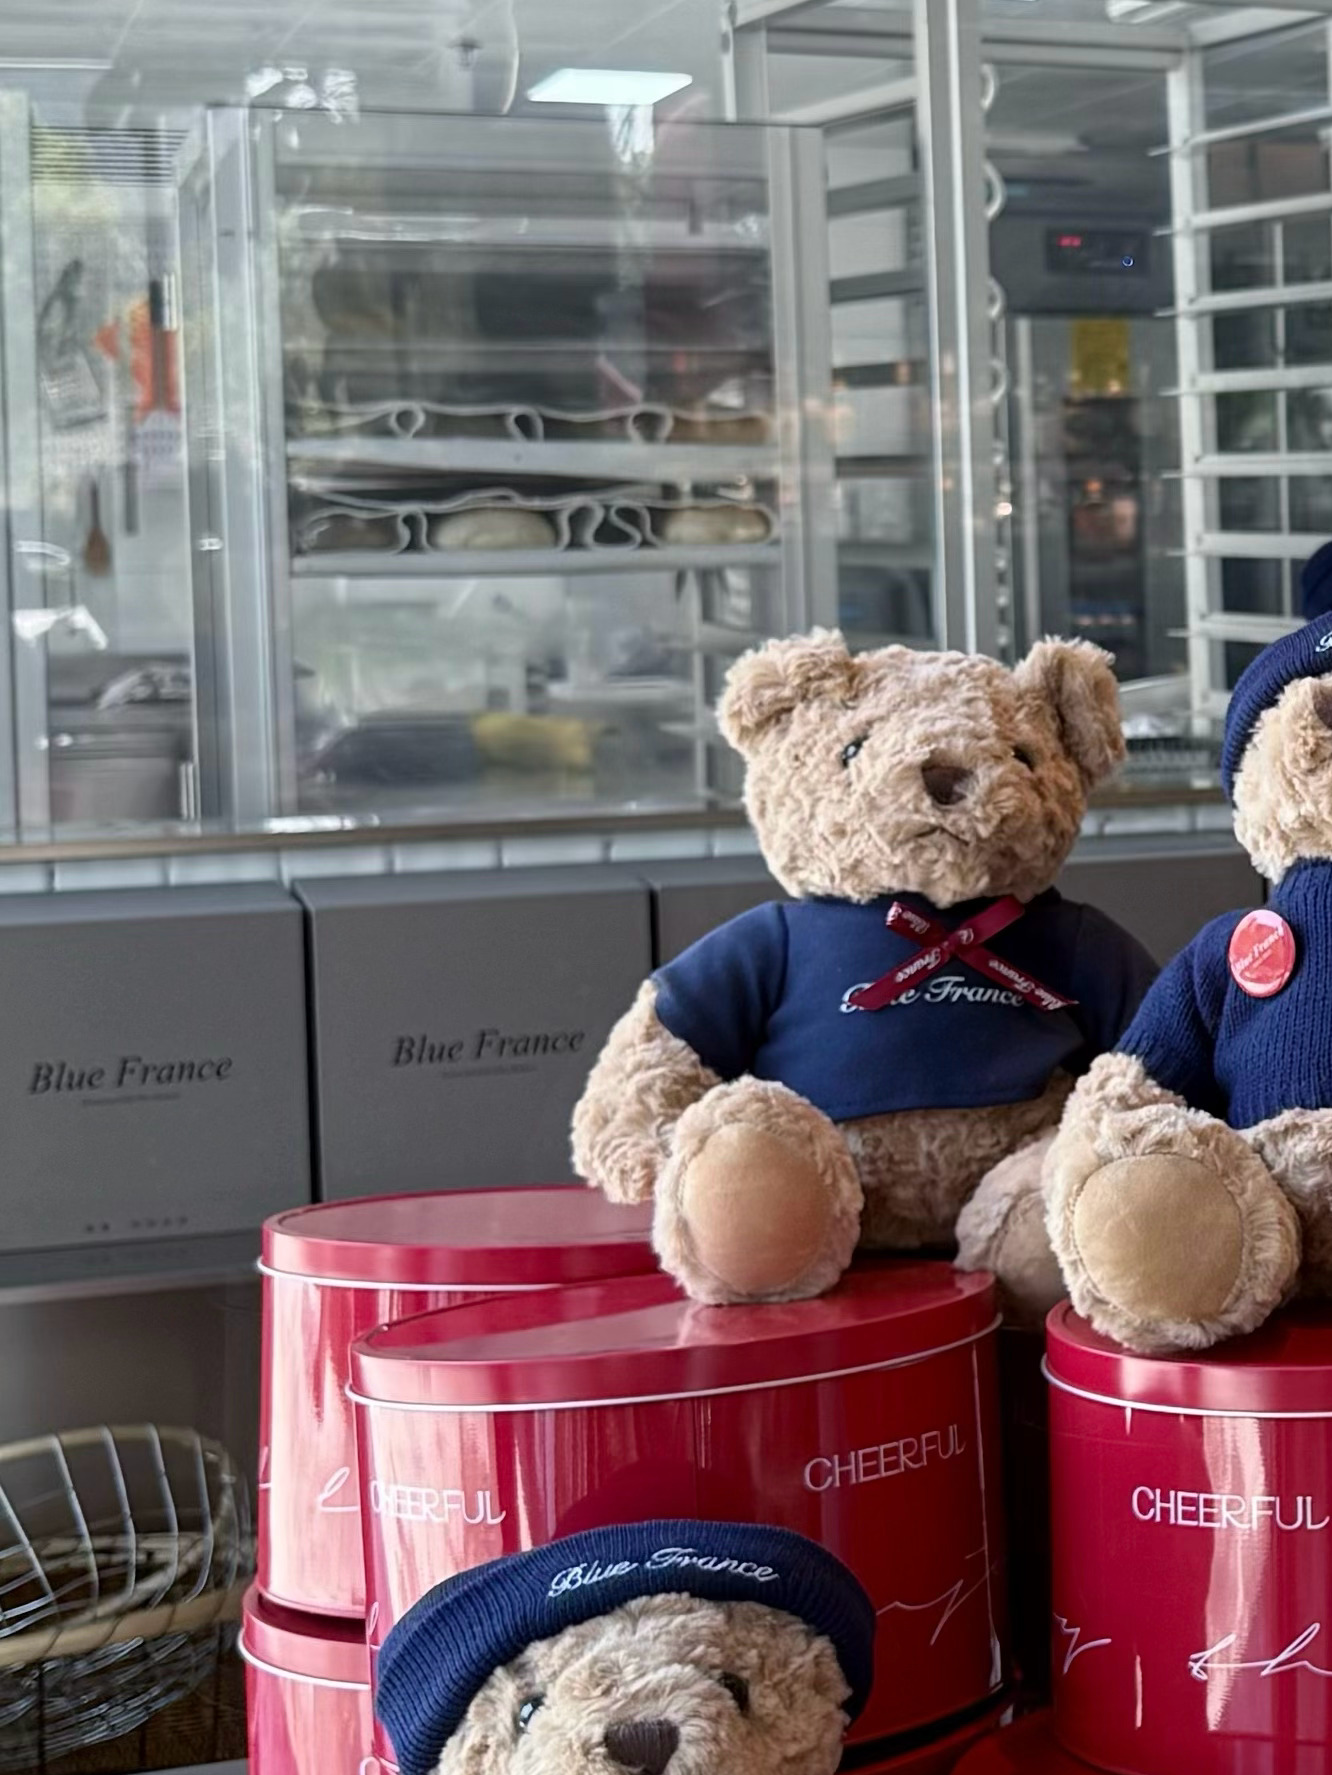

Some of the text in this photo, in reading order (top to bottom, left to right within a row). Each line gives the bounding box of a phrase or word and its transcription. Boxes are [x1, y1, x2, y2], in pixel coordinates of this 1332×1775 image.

[923, 975, 1026, 1008] France
[392, 1027, 587, 1068] Blue France
[27, 1053, 234, 1096] Blue France
[803, 1423, 967, 1493] CHEERFUL
[369, 1476, 507, 1526] CHEERFUL
[1131, 1485, 1331, 1531] CHEERFUL
[548, 1546, 780, 1598] Blue France
